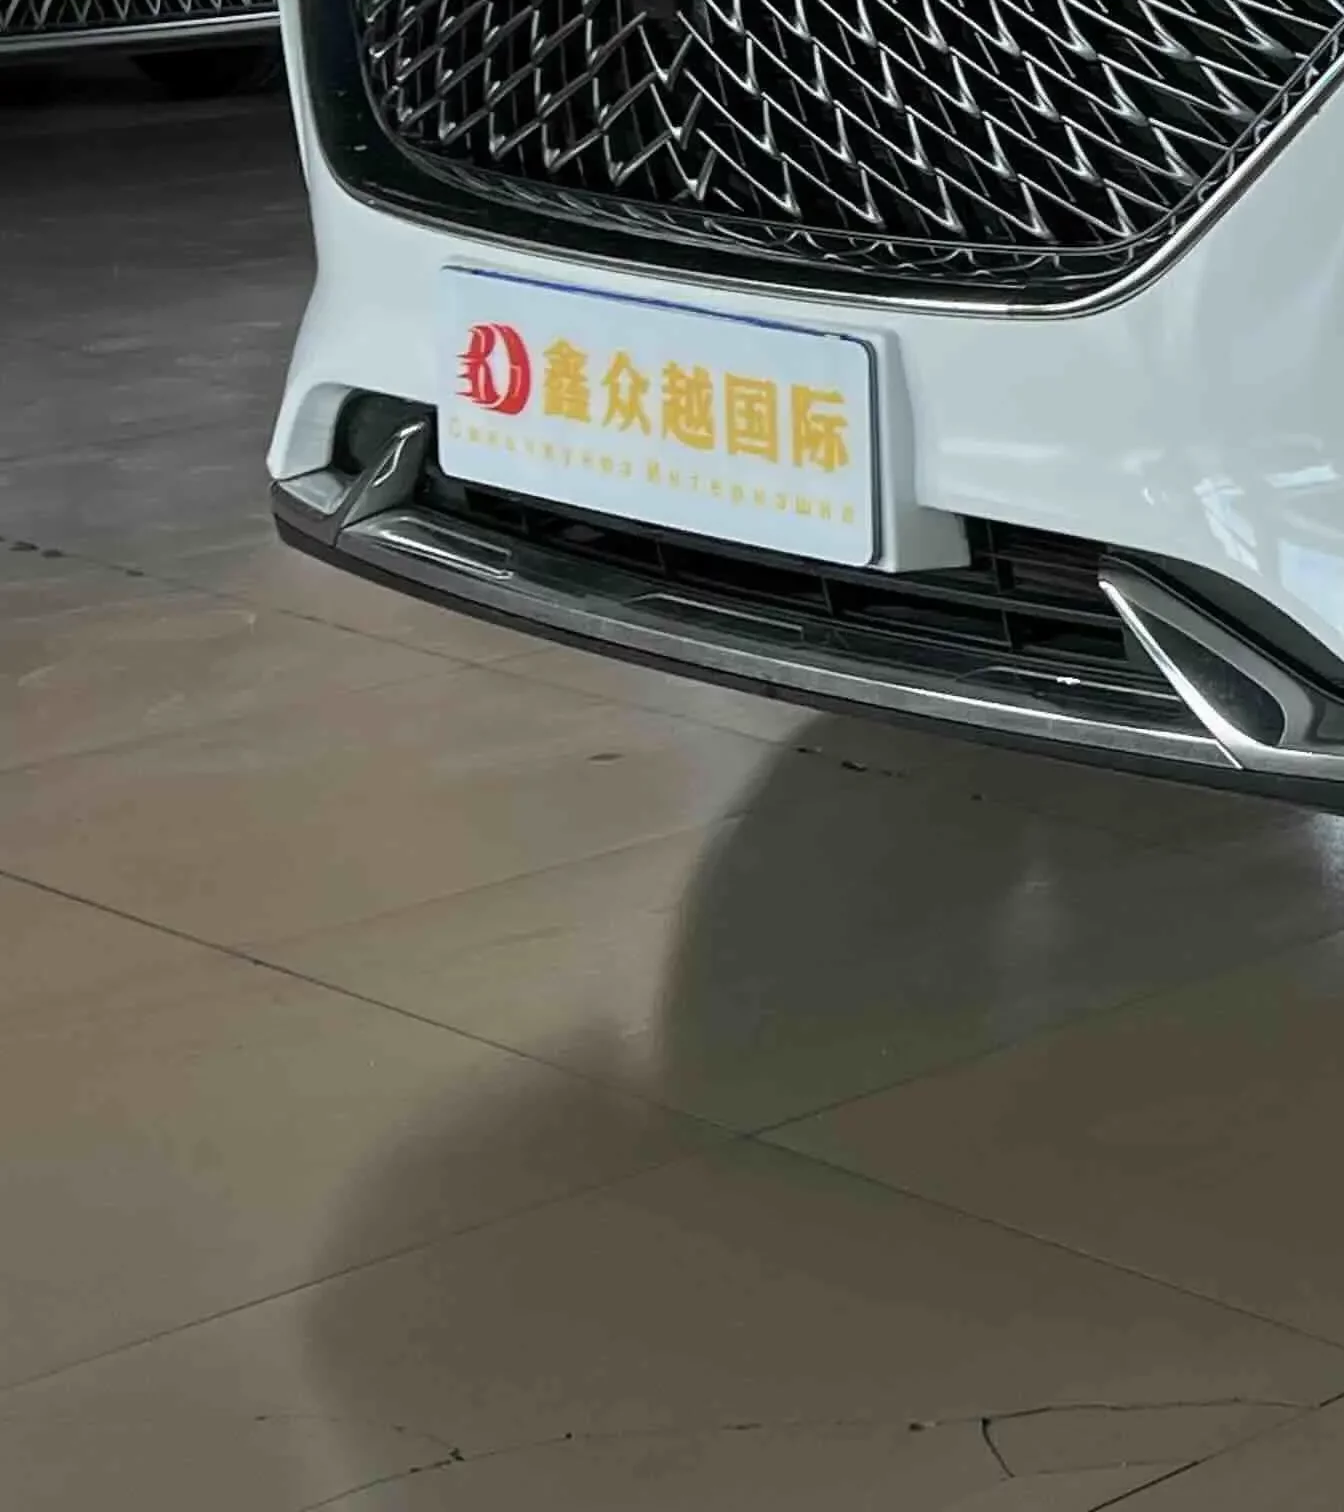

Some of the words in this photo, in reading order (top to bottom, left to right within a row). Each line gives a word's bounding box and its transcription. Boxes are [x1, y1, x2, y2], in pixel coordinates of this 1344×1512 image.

[542, 336, 850, 473] 鑫众越国际
